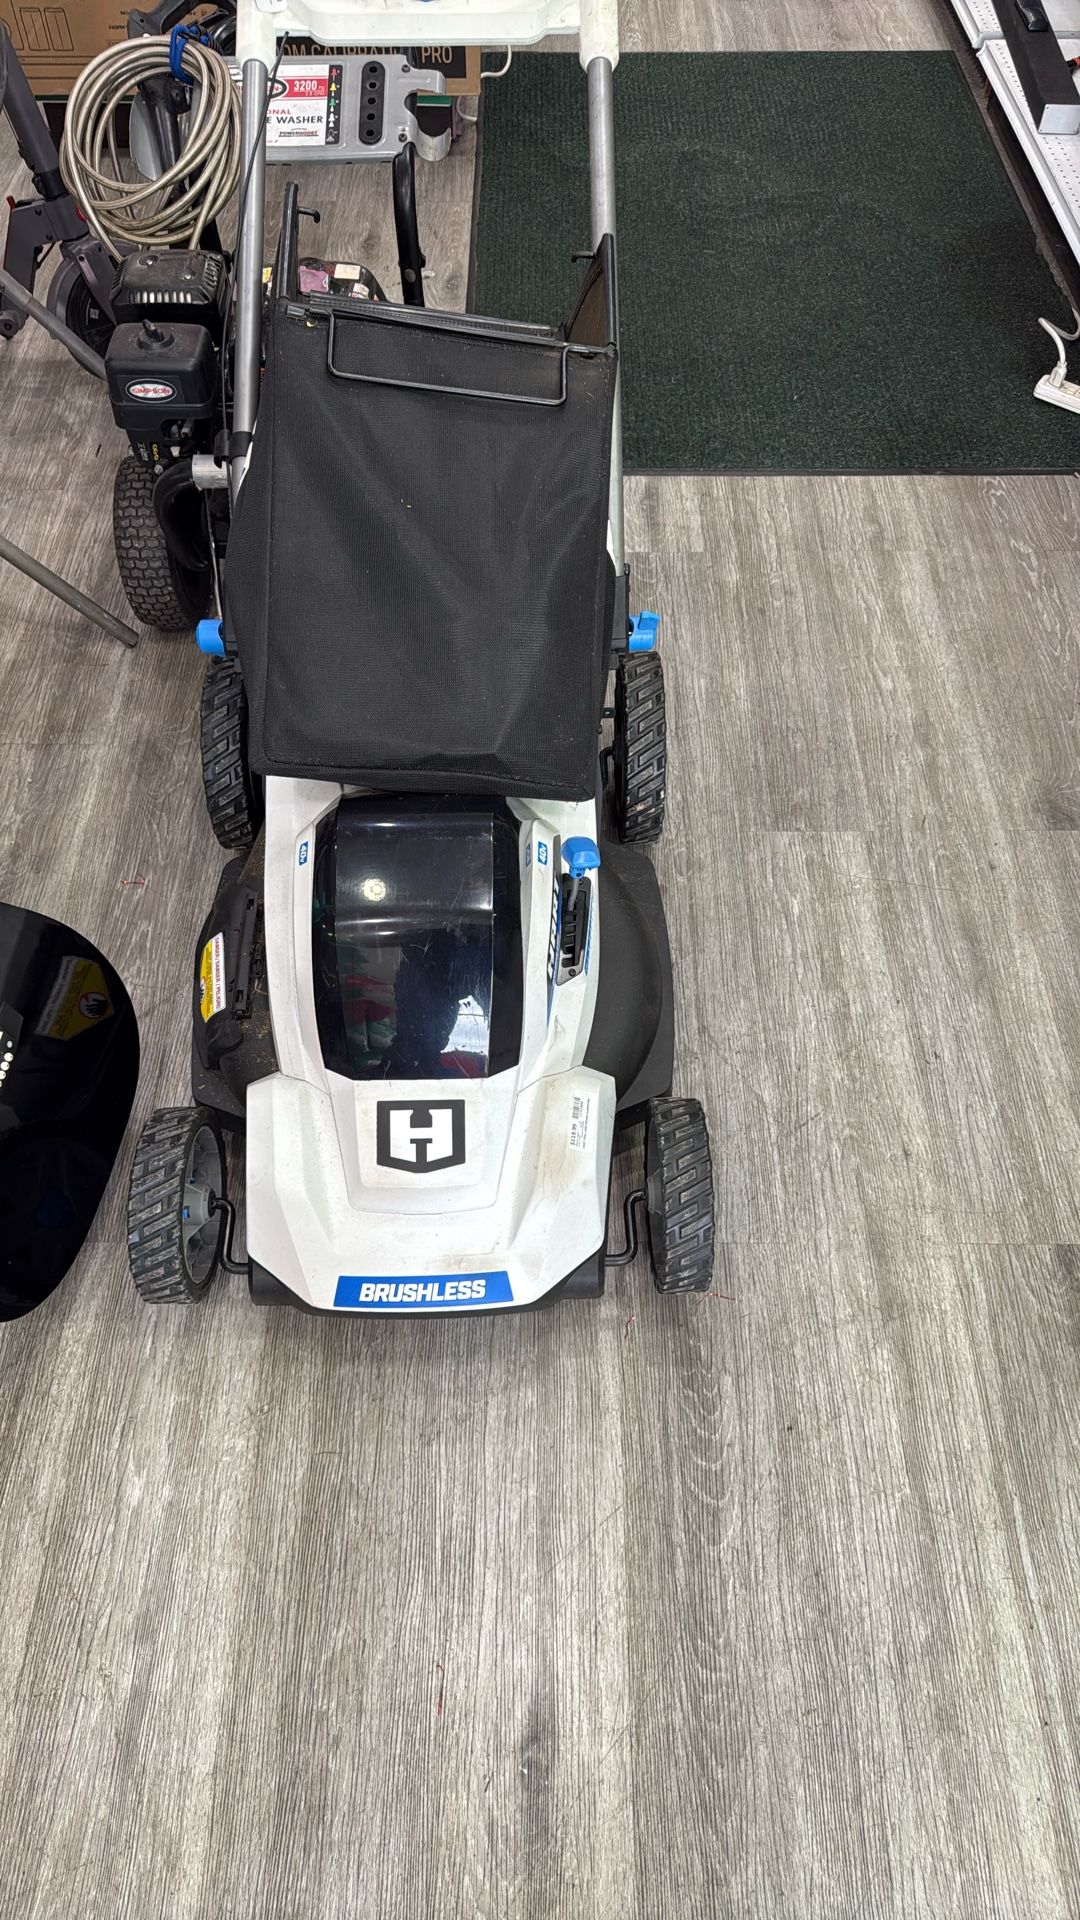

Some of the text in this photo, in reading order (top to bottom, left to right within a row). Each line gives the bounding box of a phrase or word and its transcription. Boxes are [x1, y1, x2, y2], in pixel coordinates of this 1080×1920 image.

[421, 46, 453, 64] PRO
[293, 80, 318, 91] 3200
[276, 116, 324, 124] WASHER
[131, 387, 170, 395] SIMPSON
[358, 1279, 487, 1303] BRUSHLESS
